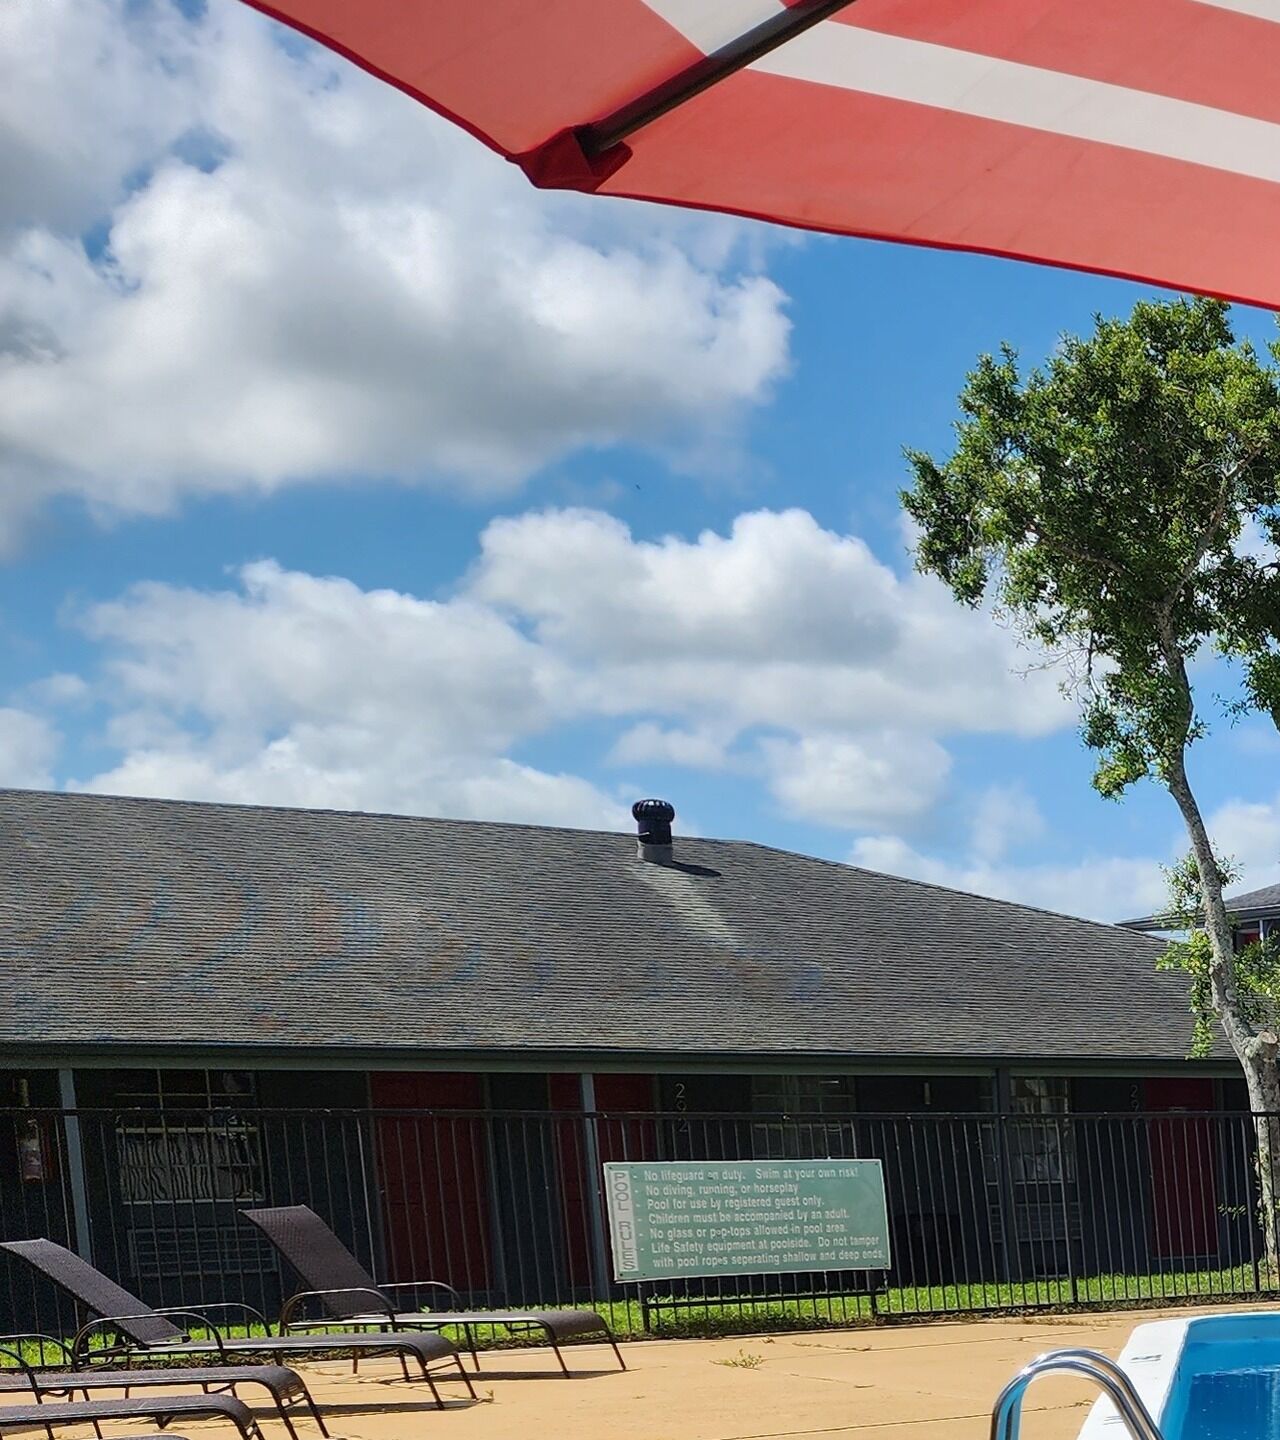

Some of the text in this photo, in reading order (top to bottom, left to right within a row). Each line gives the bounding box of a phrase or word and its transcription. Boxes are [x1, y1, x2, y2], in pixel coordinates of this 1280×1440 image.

[644, 1169, 658, 1180] No
[661, 1169, 704, 1183] lifeguard
[722, 1169, 746, 1182] duty.
[755, 1168, 780, 1179] Swim
[783, 1168, 793, 1178] at
[795, 1169, 816, 1181] your
[818, 1169, 836, 1178] own
[839, 1167, 859, 1177] risk!
[646, 1185, 659, 1196] No
[741, 1185, 751, 1193] or
[754, 1182, 800, 1195] horseplay
[647, 1195, 825, 1210] Pool for use by registered guest only.
[614, 1172, 636, 1270] POOL RULES
[648, 1208, 850, 1224] Children must be accompanied by an adult.
[650, 1228, 664, 1239] No
[667, 1227, 693, 1241] glass
[697, 1228, 707, 1238] or
[754, 1224, 789, 1235] allowed
[791, 1223, 800, 1234] in
[803, 1223, 823, 1235] pool
[651, 1235, 879, 1254] Life Safety equipment at poolside. Do not tamper
[653, 1256, 674, 1267] with
[677, 1255, 699, 1268] pool
[731, 1253, 780, 1266] seperating
[783, 1251, 817, 1262] shallow
[820, 1249, 836, 1260] and
[839, 1249, 859, 1261] deep
